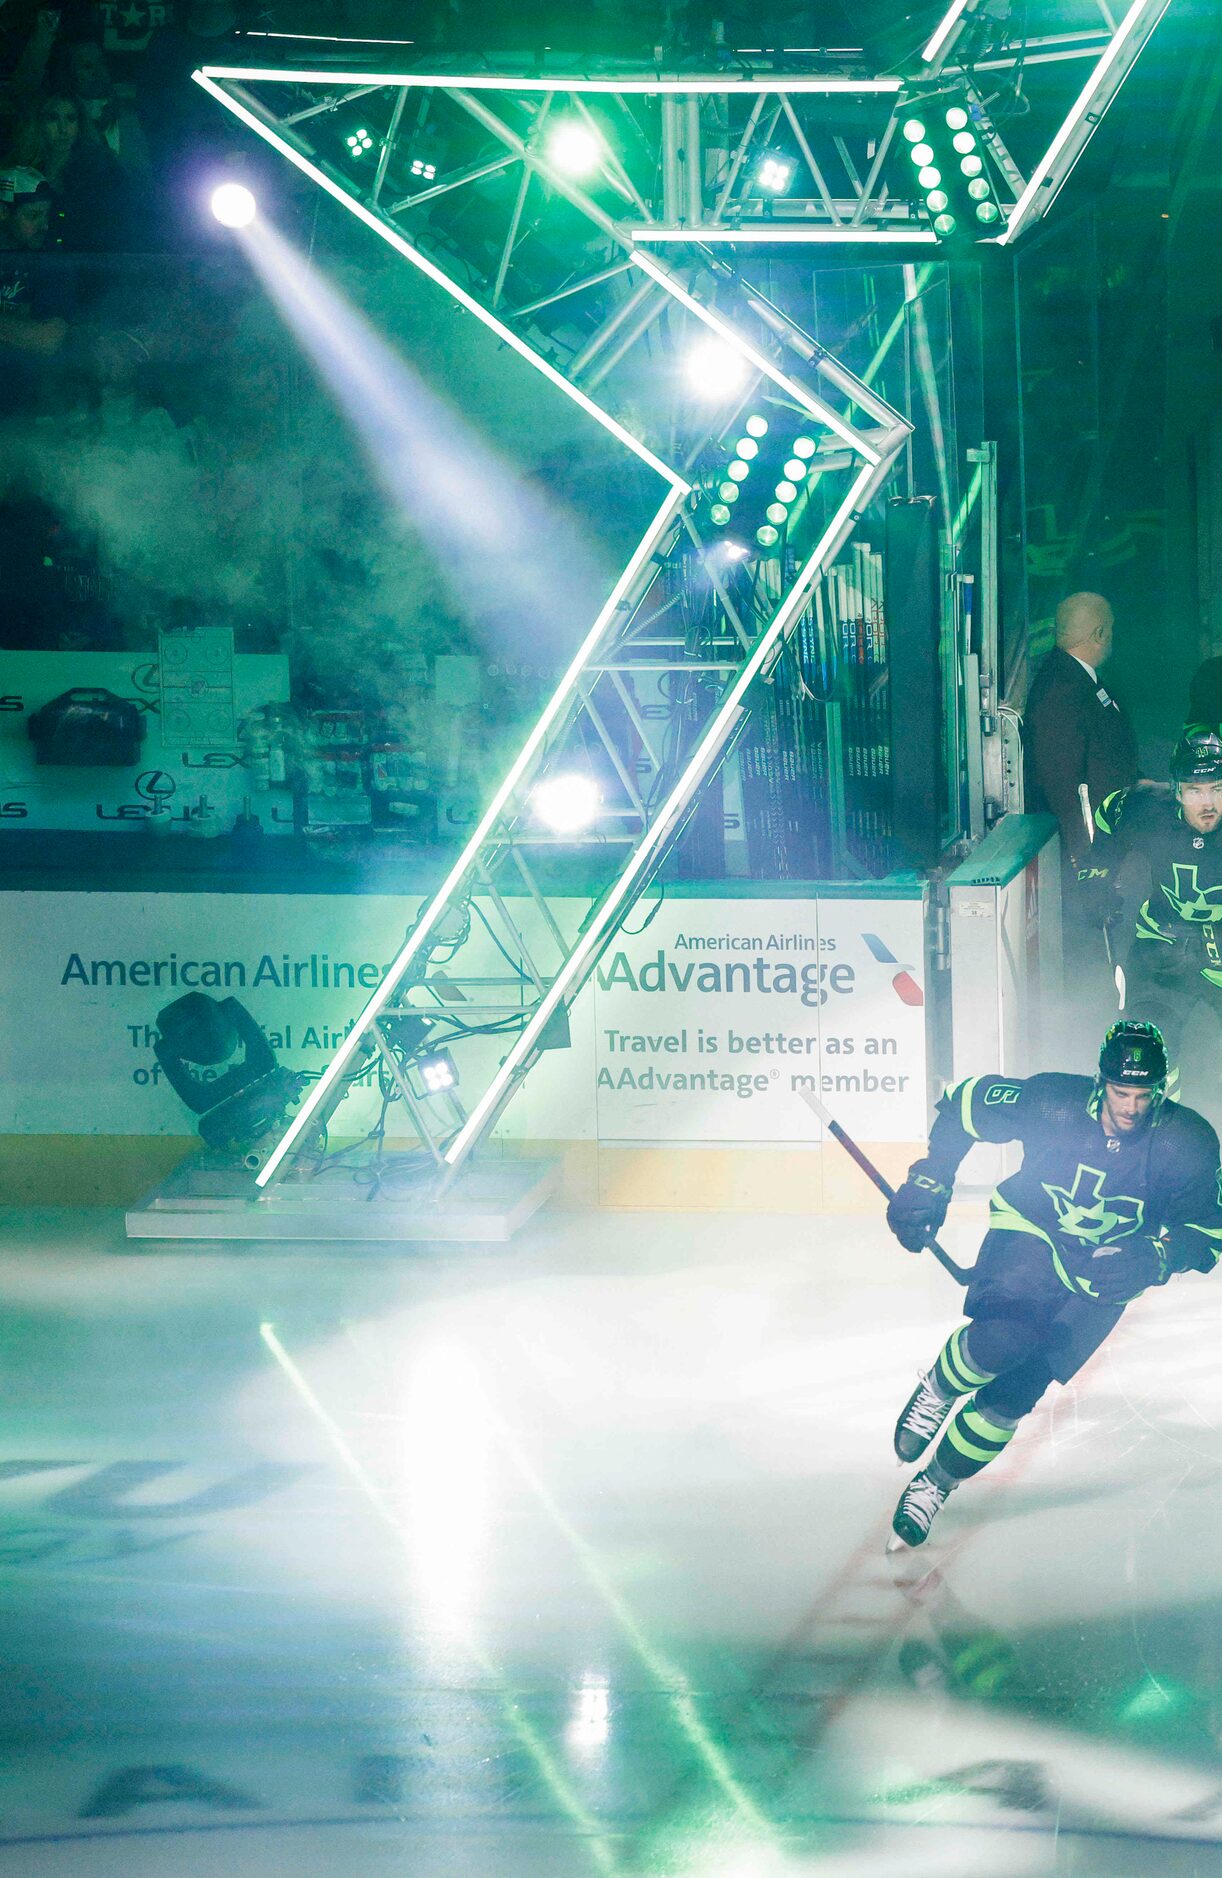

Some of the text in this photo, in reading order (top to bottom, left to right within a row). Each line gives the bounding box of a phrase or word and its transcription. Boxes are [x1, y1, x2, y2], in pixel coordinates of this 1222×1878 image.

[674, 933, 837, 952] American Airlines
[60, 952, 246, 988] American
[603, 1029, 898, 1055] Travel is better as an
[132, 1062, 162, 1086] of
[790, 1069, 910, 1093] member
